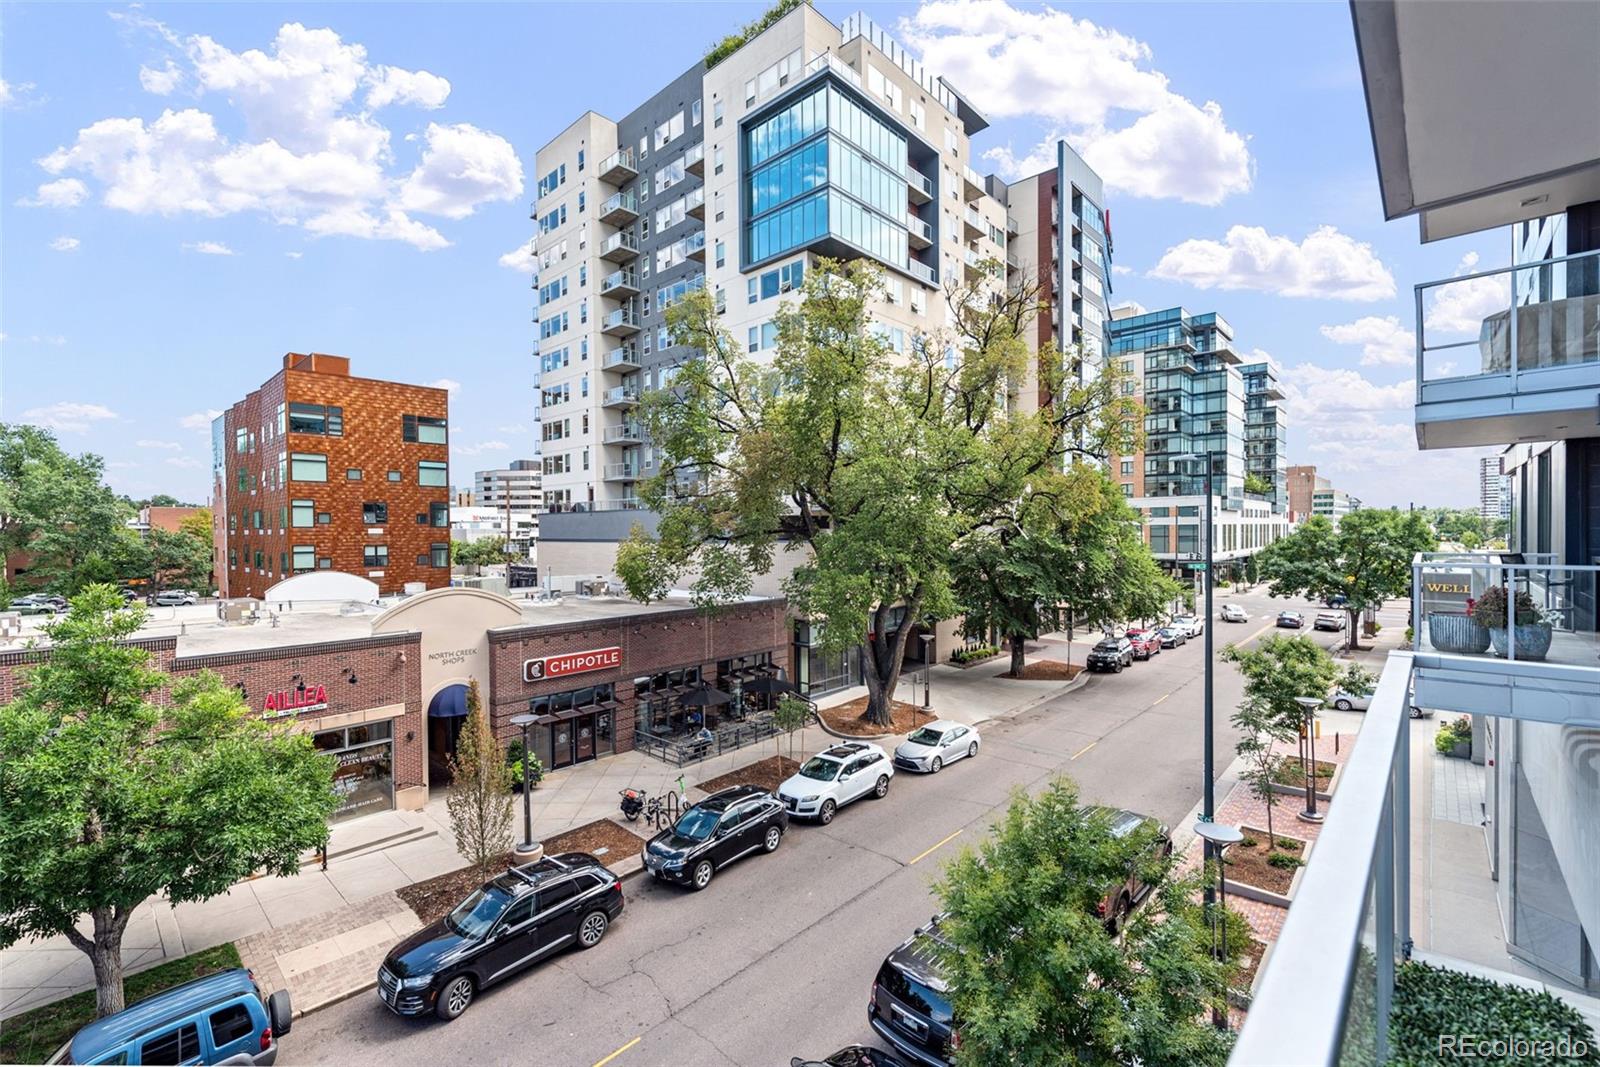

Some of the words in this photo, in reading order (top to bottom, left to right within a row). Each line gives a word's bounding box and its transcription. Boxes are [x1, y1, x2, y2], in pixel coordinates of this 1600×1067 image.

[429, 651, 454, 660] NORTH
[456, 648, 477, 656] CREEK
[442, 656, 464, 665] SHOPS
[550, 652, 619, 673] CHIPOTLE
[264, 684, 327, 711] AILLEA
[340, 759, 360, 767] CLEAN
[361, 753, 384, 763] BEAUTY
